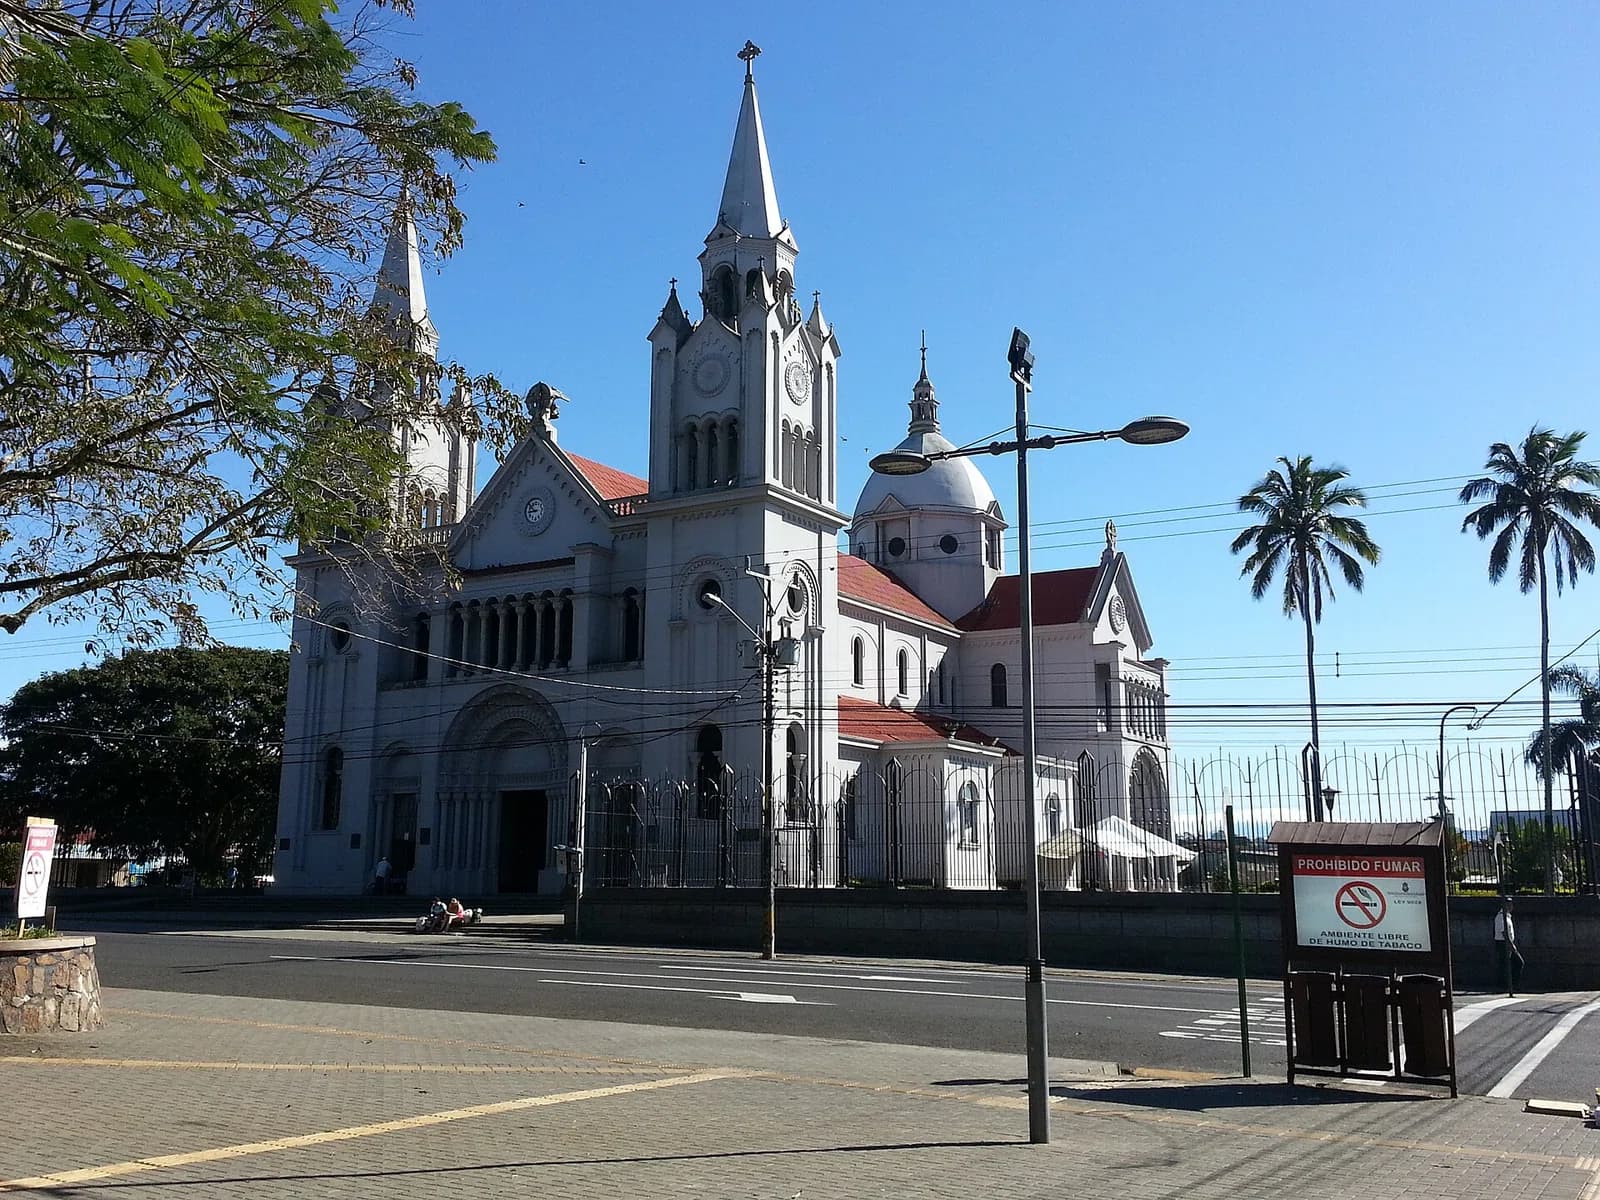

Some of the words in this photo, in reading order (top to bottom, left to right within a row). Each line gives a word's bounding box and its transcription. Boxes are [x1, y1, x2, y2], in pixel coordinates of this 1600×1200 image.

[1298, 859, 1370, 871] PROHIBIDO
[1374, 861, 1421, 872] FUMAR
[1320, 930, 1374, 939] AMBIENTE
[1378, 933, 1409, 941] LIBRE
[1326, 939, 1358, 947] HUMO
[1379, 941, 1422, 950] TABACO
